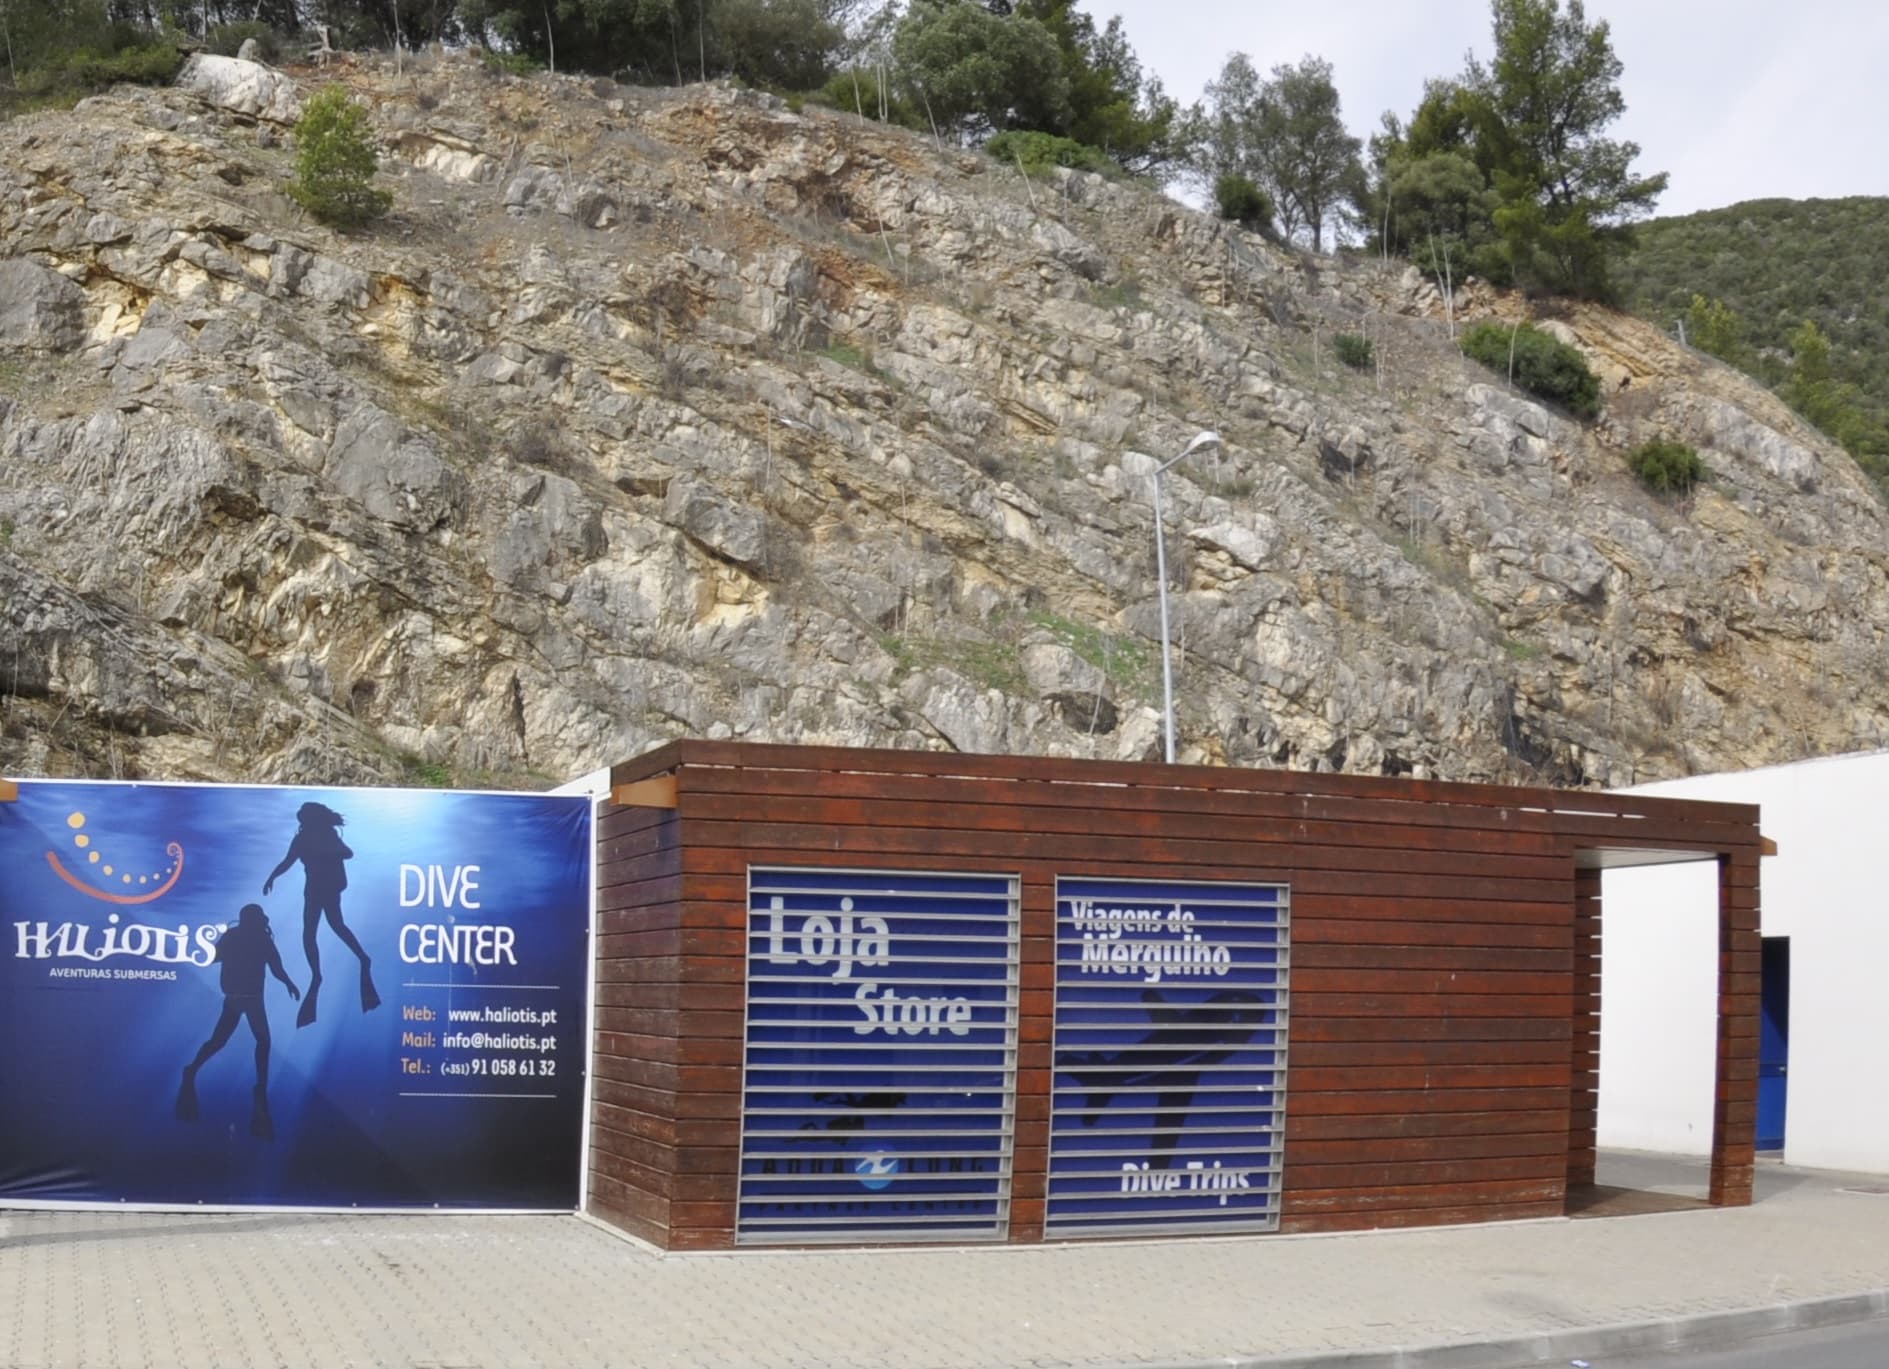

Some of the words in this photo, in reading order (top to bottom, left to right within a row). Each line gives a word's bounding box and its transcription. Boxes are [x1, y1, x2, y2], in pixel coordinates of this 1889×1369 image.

[399, 863, 480, 909] DIVE
[769, 896, 890, 985] Loja
[1070, 900, 1162, 940] Viagens
[1167, 903, 1195, 933] de
[399, 923, 518, 966] CENTER
[1081, 932, 1231, 983] Mergulho
[49, 967, 112, 979] AVENTURAS
[113, 969, 178, 981] SUBMERSAS
[402, 1005, 437, 1022] Web:
[448, 1006, 558, 1028] www.haliotis.pt
[854, 982, 972, 1036] Store
[401, 1032, 436, 1048] Mail:
[442, 1031, 557, 1054] info@haliotis.pt
[401, 1057, 432, 1075] Tel.:
[471, 1058, 488, 1075] 91
[491, 1058, 517, 1076] 058
[519, 1059, 536, 1077] 61
[538, 1059, 556, 1077] 32
